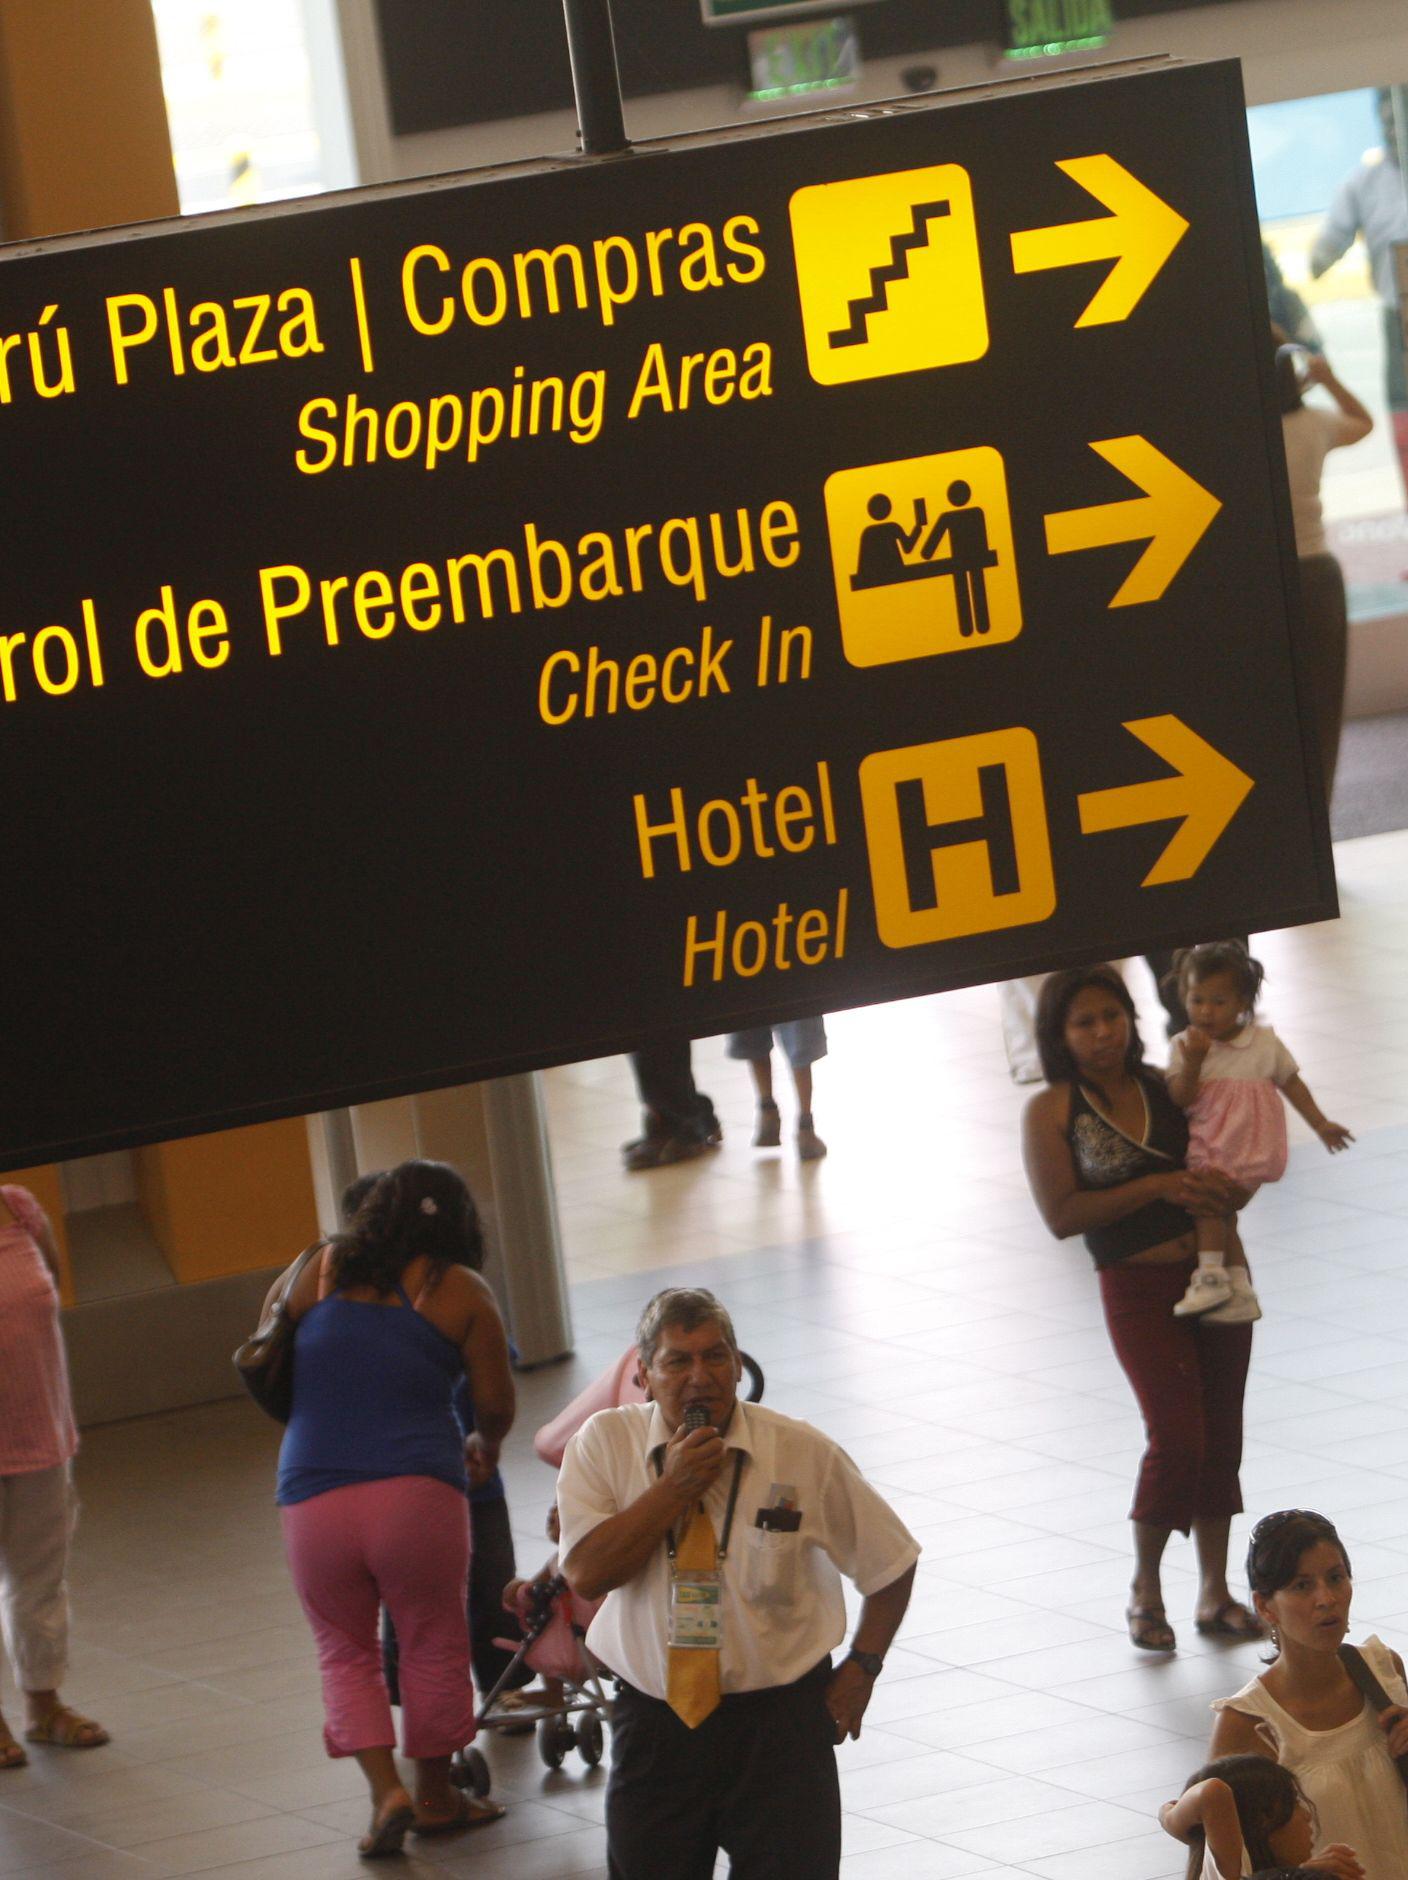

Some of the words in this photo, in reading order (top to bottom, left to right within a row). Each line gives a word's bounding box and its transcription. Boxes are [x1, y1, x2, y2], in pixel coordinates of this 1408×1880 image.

[0, 303, 76, 405] rú
[105, 285, 326, 386] Plaza
[401, 213, 768, 338] Compras
[294, 366, 607, 476] Shopping
[627, 341, 775, 420] Area
[0, 597, 105, 704] rol
[133, 583, 231, 680] de
[257, 500, 802, 658] Preembarque
[537, 622, 732, 727] Check
[756, 614, 814, 690] In
[632, 760, 838, 881] Hotel
[893, 762, 1022, 914] H
[682, 887, 849, 988] Hotel
